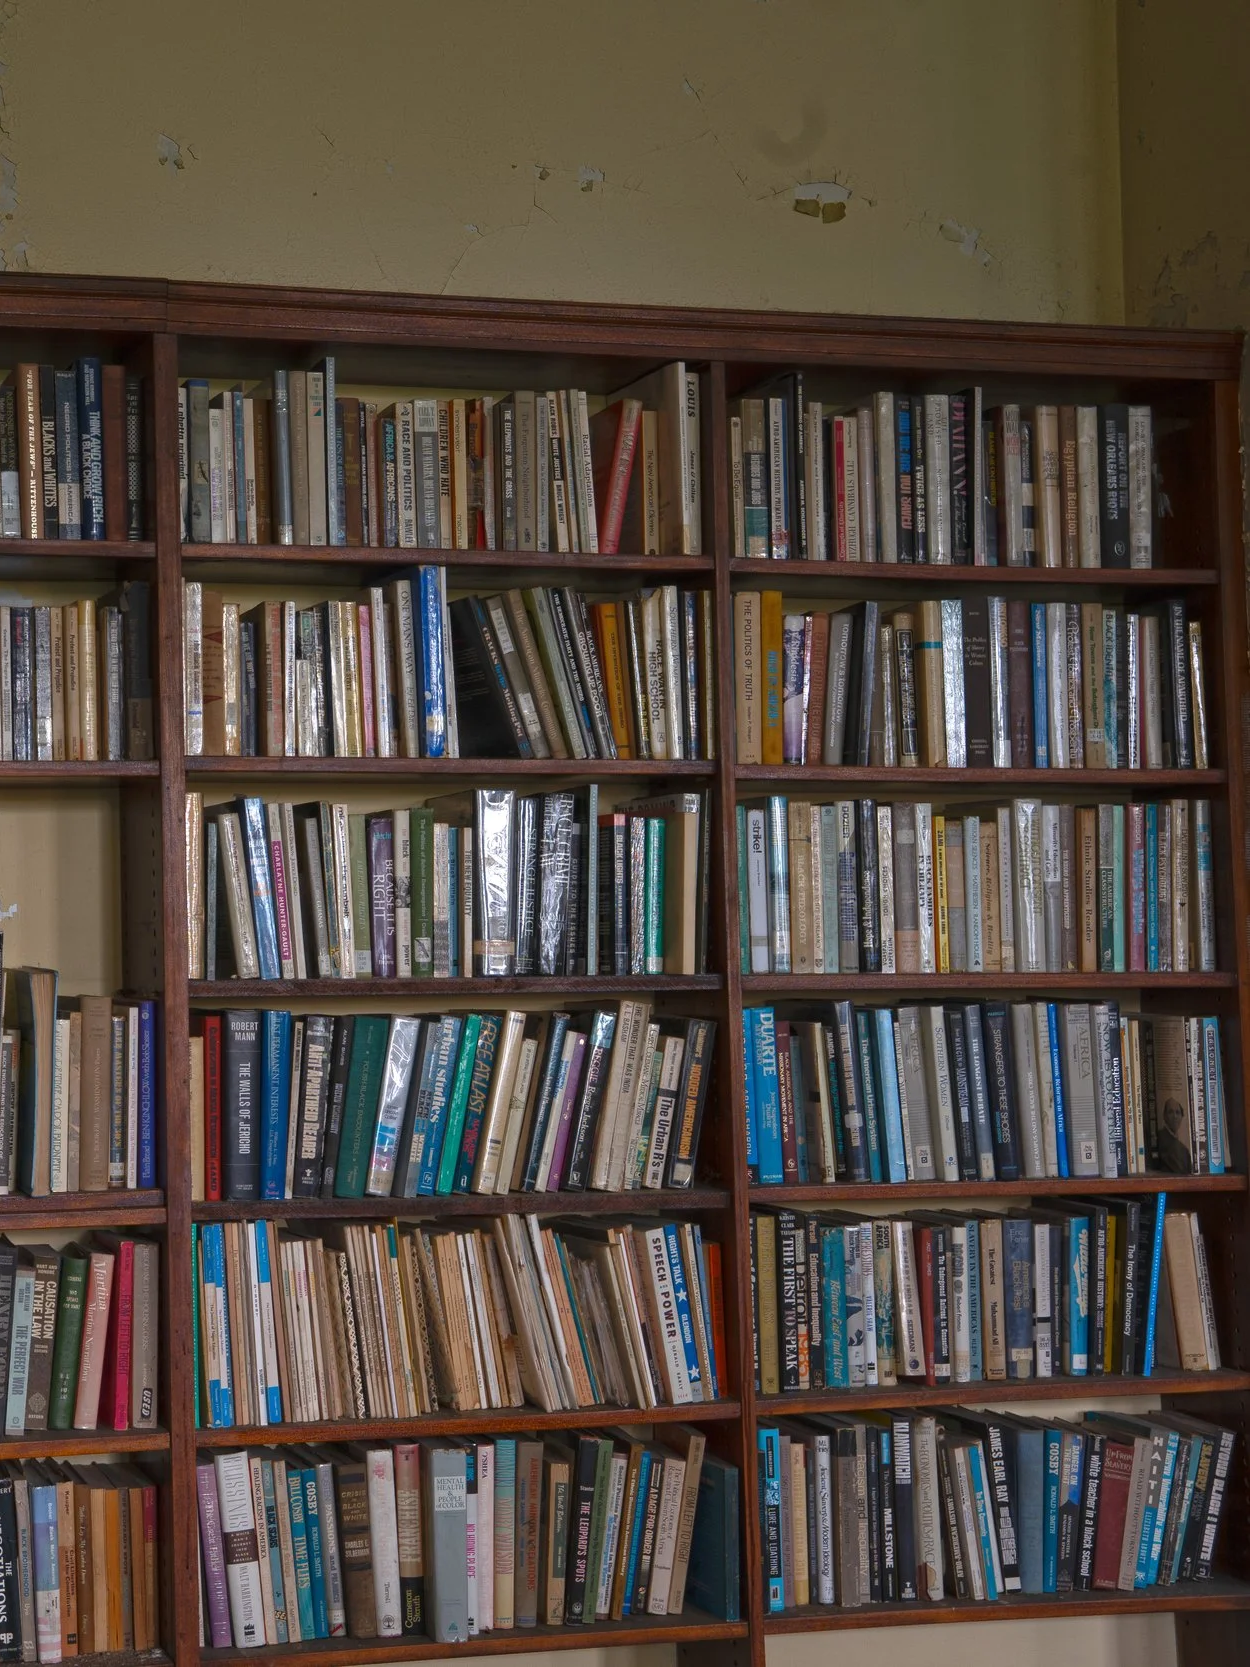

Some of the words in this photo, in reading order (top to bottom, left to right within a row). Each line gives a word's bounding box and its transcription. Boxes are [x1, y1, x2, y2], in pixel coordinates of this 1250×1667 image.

[687, 380, 695, 417] LOUIS
[89, 411, 101, 437] THINK
[401, 420, 411, 445] RACE
[439, 409, 448, 451] CHILDREN
[90, 439, 101, 460] AND
[402, 447, 411, 467] AND
[440, 455, 449, 475] WHO
[1064, 440, 1076, 488] Egyptian
[90, 462, 103, 494] GROW
[403, 468, 412, 511] POLITICS
[441, 477, 449, 497] HATE
[91, 495, 104, 523] RICH
[1066, 492, 1077, 536] Religion
[744, 600, 752, 616] THE
[744, 618, 752, 656] POLITICS
[648, 651, 658, 677] HIGH
[744, 659, 752, 670] OF
[650, 680, 659, 724] SCHOOL
[744, 673, 753, 701] TRUTH
[752, 819, 762, 854] strike!
[273, 845, 285, 894] CHARLAYNE
[373, 874, 385, 920] RIGHT
[278, 896, 290, 957] HUNTER-GAULT
[1085, 909, 1093, 943] Reader
[759, 1012, 776, 1077] DUARTE
[1079, 1026, 1090, 1080] AFRICA
[239, 1062, 250, 1077] THE
[688, 1063, 702, 1096] HOODED
[239, 1082, 251, 1107] WALLS
[662, 1098, 674, 1116] The
[239, 1109, 250, 1119] OF
[678, 1098, 698, 1159] AMERICANISM
[239, 1121, 250, 1154] JERICHO
[655, 1118, 671, 1151] Urban
[667, 1234, 680, 1264] RIGHTS
[782, 1237, 794, 1266] THE
[670, 1265, 683, 1285] TALK
[783, 1268, 795, 1303] FIRST
[810, 1253, 819, 1290] Education
[652, 1237, 665, 1282] SPEECH
[661, 1291, 677, 1338] POWER
[811, 1291, 819, 1307] and
[681, 1313, 691, 1344] GLENDON
[784, 1309, 796, 1327] TO
[811, 1308, 821, 1346] Inequality
[785, 1330, 797, 1370] SPEAK
[141, 1390, 152, 1416] USED
[894, 1422, 911, 1479] KLANWATCH
[989, 1426, 1002, 1458] JAMES
[993, 1460, 1007, 1484] EARL
[1049, 1442, 1059, 1476] COSBY
[1089, 1455, 1101, 1477] white
[306, 1482, 318, 1515] COSBY
[581, 1501, 590, 1516] THE
[997, 1485, 1009, 1503] RAY
[1086, 1479, 1099, 1508] teacher
[1086, 1510, 1097, 1518] in
[577, 1518, 589, 1557] LEOPARD'S
[883, 1508, 893, 1568] MILLSTONE
[1083, 1527, 1095, 1549] black
[575, 1559, 587, 1583] SPOTS
[1080, 1550, 1092, 1576] school
